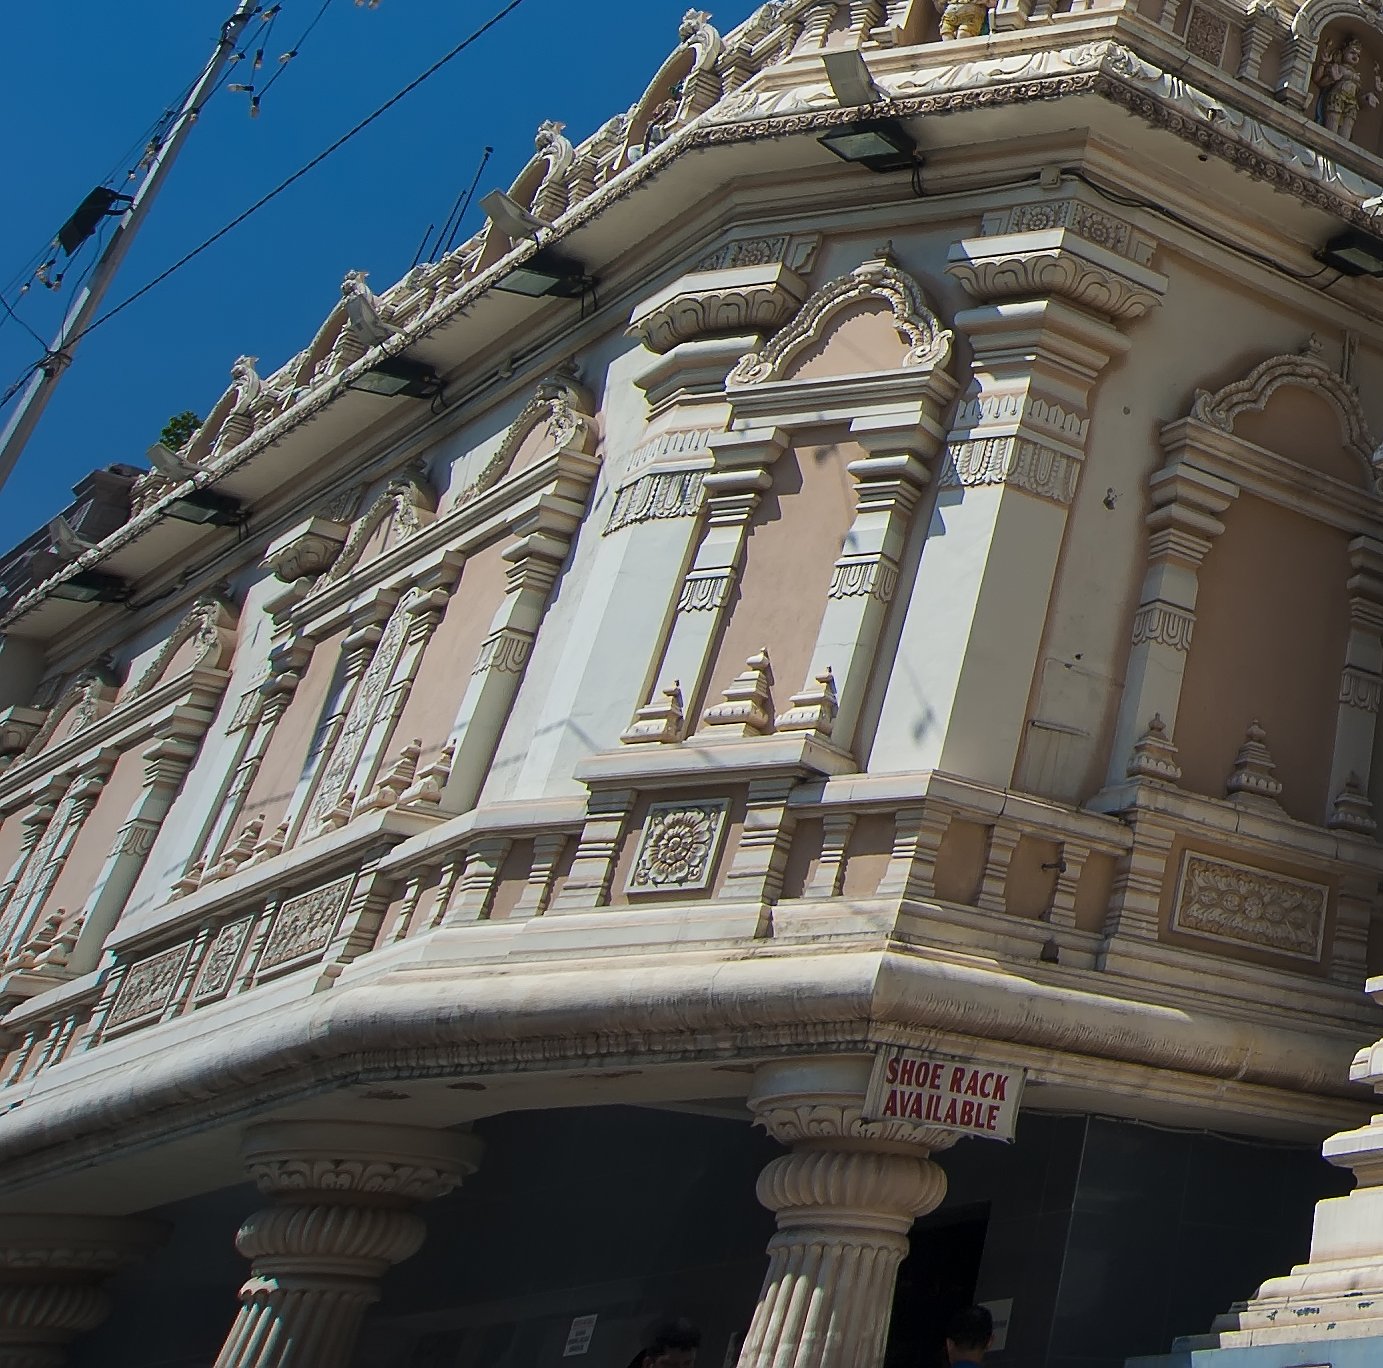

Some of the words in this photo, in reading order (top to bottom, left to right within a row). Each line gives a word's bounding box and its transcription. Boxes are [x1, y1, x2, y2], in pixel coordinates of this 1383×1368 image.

[886, 1057, 945, 1091] SHOE
[949, 1066, 1010, 1101] RACK
[881, 1089, 1001, 1131] AVAILABLE
